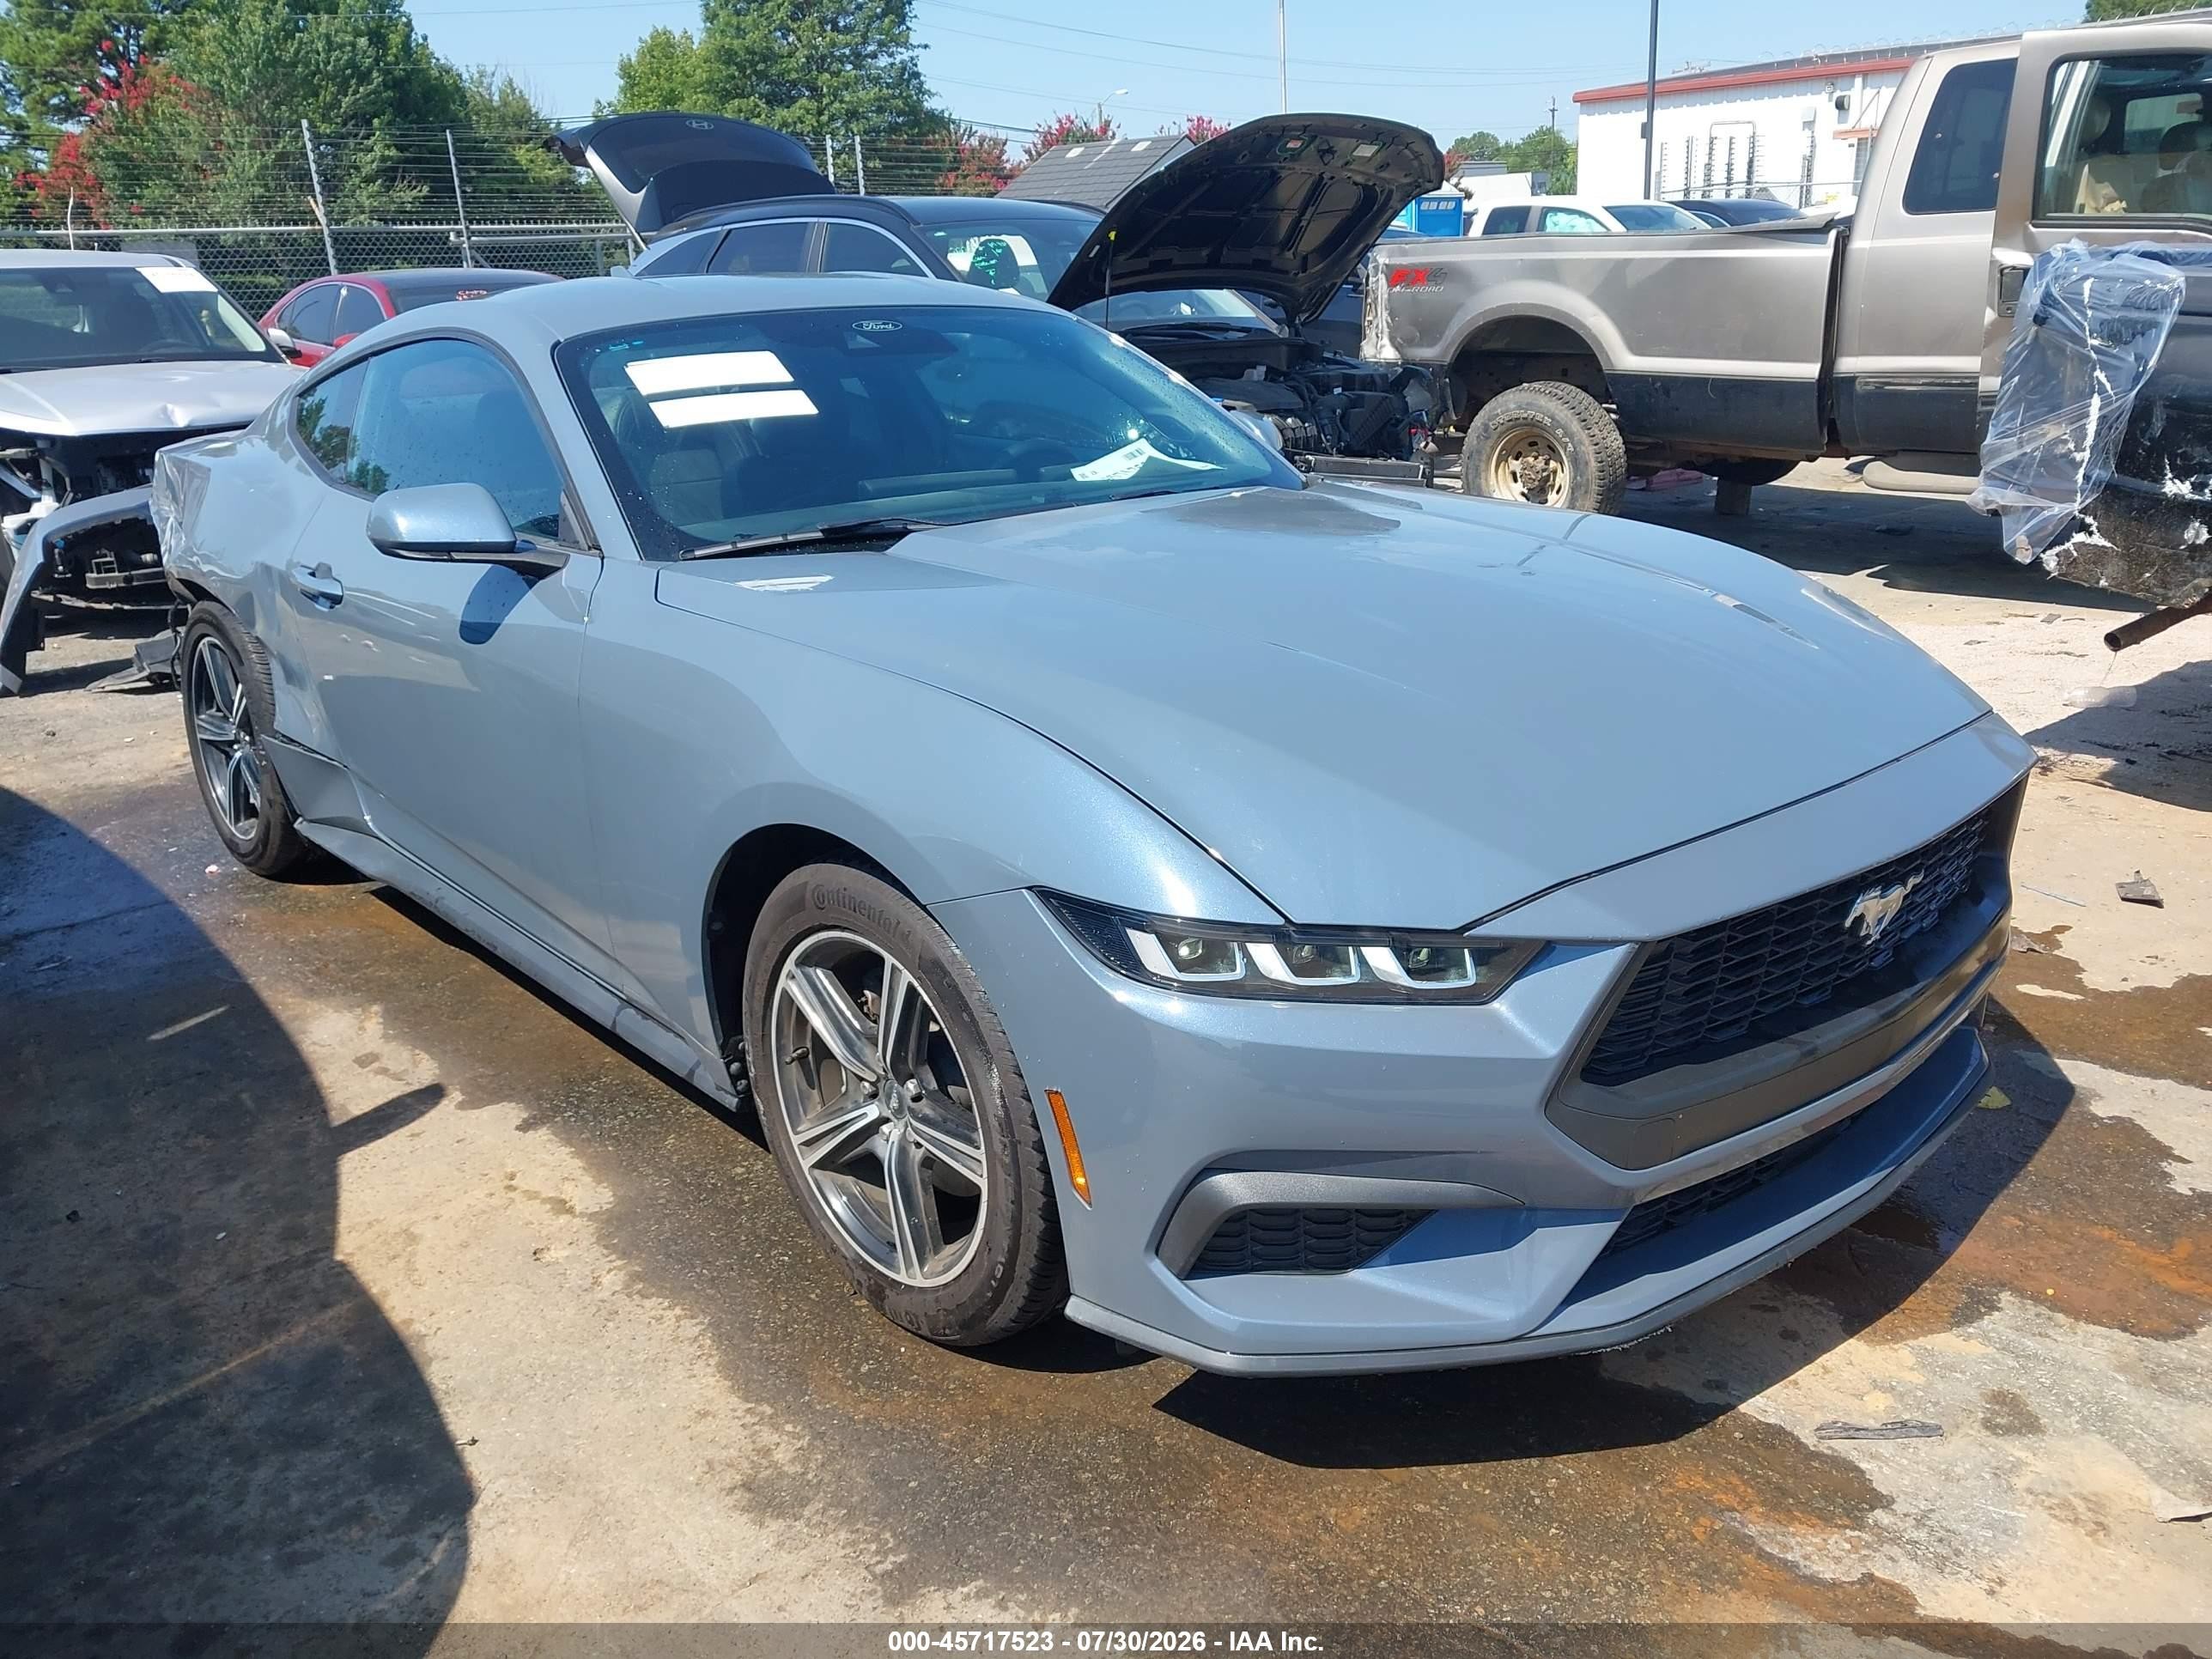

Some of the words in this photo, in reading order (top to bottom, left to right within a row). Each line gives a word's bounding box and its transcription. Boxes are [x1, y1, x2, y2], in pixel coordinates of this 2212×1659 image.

[1389, 267, 1448, 287] FX4
[862, 321, 895, 330] Ford
[811, 884, 901, 939] Continental
